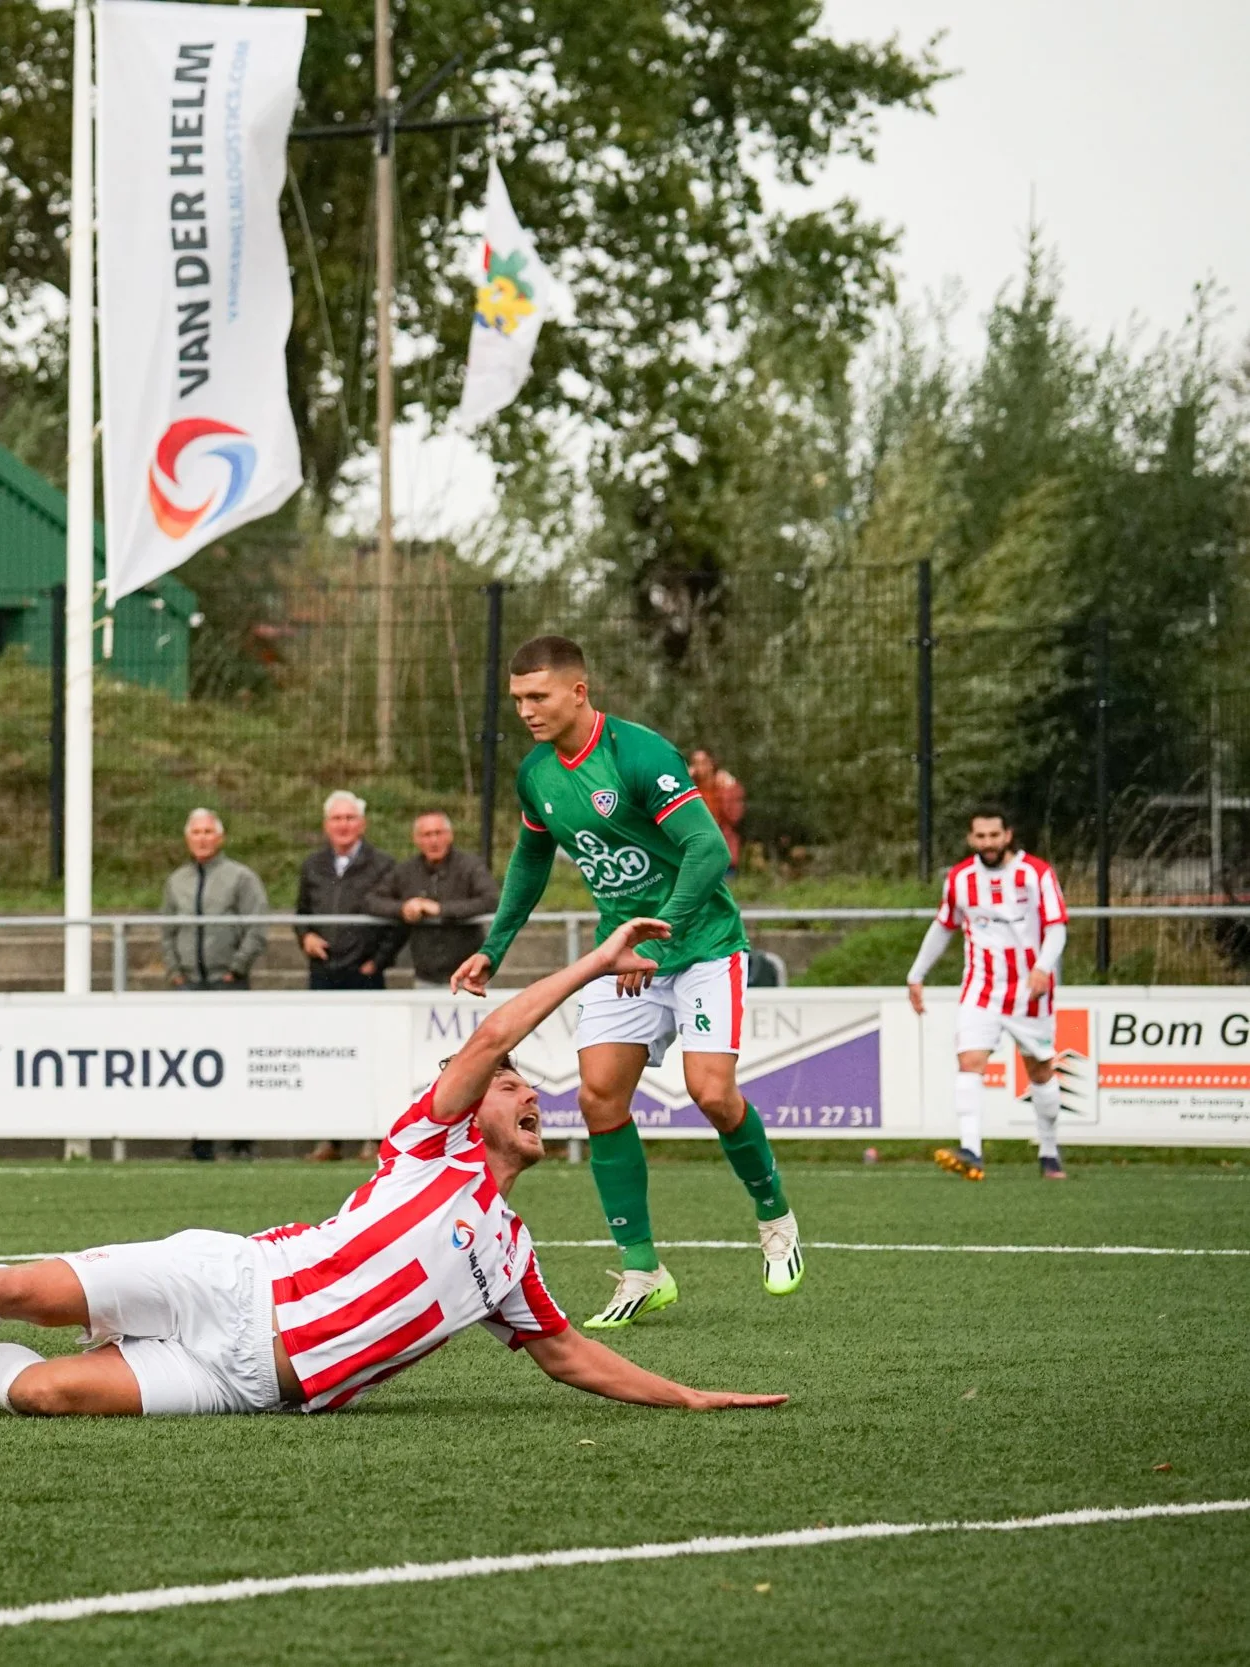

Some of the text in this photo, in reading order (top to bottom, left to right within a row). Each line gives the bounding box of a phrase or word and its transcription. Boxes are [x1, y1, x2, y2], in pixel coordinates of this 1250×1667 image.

[170, 42, 214, 399] VAN DER HELM
[695, 997, 703, 1009] 3
[1110, 1013, 1202, 1046] Bom
[16, 1048, 224, 1088] INTRIXO
[777, 1105, 812, 1126] 711
[819, 1105, 846, 1126] 27
[850, 1105, 873, 1127] 31
